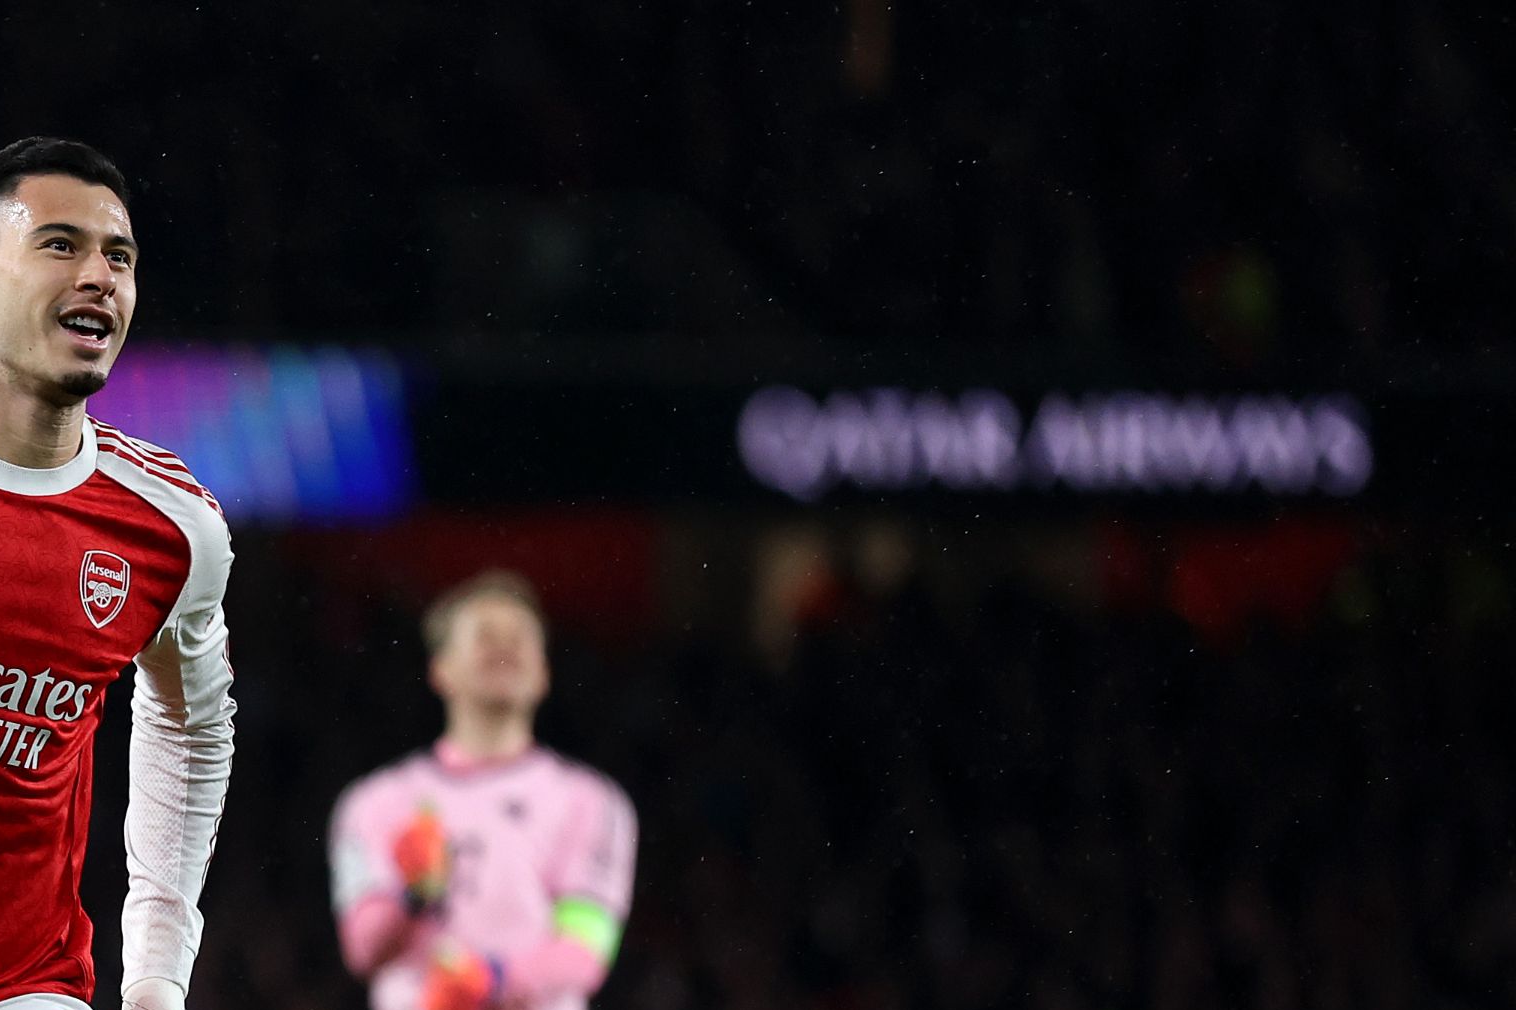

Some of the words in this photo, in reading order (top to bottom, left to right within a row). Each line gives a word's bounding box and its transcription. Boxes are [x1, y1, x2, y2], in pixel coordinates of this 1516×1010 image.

[737, 386, 1024, 500] QATAR
[1024, 390, 1372, 498] AIRWAYS
[88, 562, 124, 582] Arsenal
